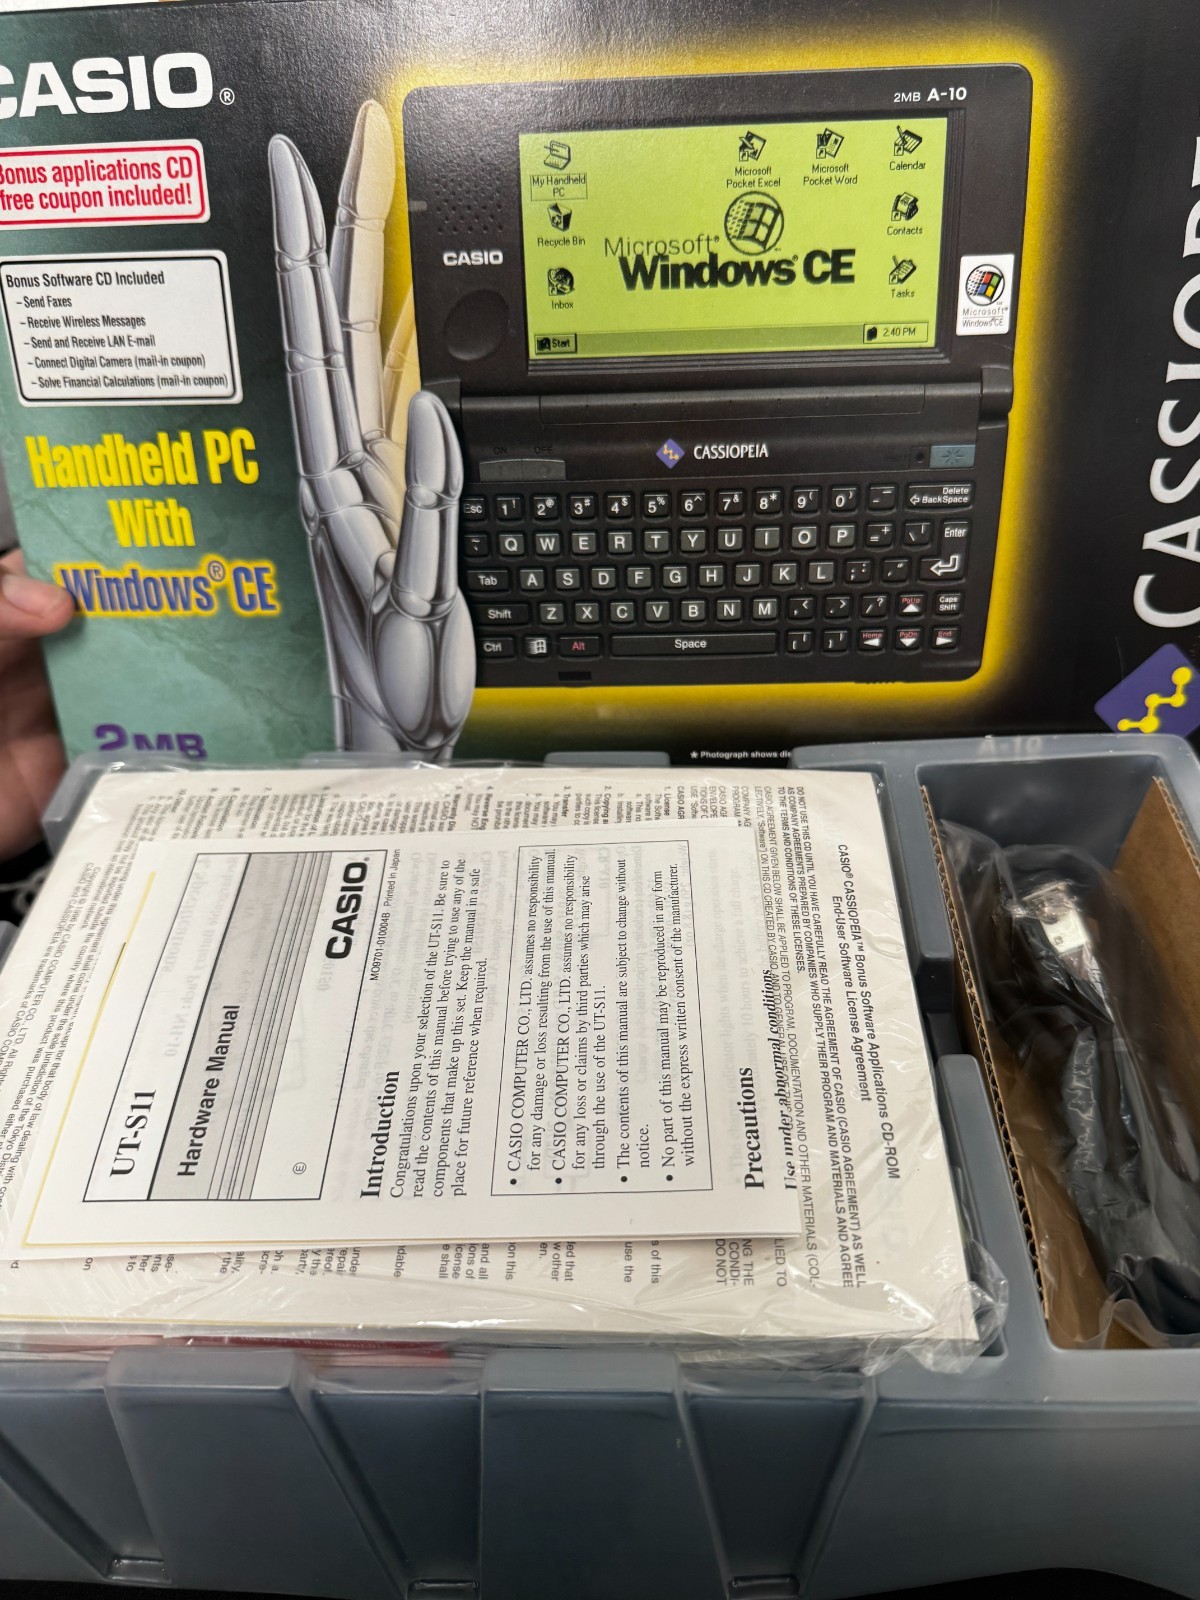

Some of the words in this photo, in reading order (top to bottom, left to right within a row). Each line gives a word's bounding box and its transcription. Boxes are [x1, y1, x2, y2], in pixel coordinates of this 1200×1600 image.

[893, 92, 921, 103] 2MB
[926, 87, 967, 102] A-10
[0, 164, 47, 184] onus
[52, 158, 161, 187] applications
[166, 156, 193, 178] CD
[734, 166, 772, 176] Microsoft
[810, 163, 849, 173] Microsoft
[889, 161, 926, 170] Calendar
[532, 176, 544, 187] My
[546, 174, 586, 186] Handheld
[726, 179, 756, 189] Pocket
[757, 178, 781, 188] Excel
[803, 176, 832, 186] Pocket
[834, 175, 858, 185] Word
[39, 188, 104, 213] coupon
[108, 182, 192, 206] included!
[553, 187, 565, 197] PC
[886, 226, 923, 236] Contacts
[537, 237, 570, 248] Recycle
[572, 236, 586, 246] Bin
[442, 250, 504, 267] CASIO
[803, 248, 856, 285] CE
[6, 274, 40, 288] Bonus
[42, 273, 93, 286] Software
[95, 272, 112, 285] CD
[115, 270, 165, 285] Included
[890, 288, 915, 298] Tasks
[551, 301, 574, 310] Inbox
[27, 316, 61, 329] Receive
[62, 316, 100, 328] Wireless
[102, 315, 146, 330] Messages
[882, 327, 901, 337] 2:40
[902, 326, 916, 336] PM
[31, 336, 52, 348] Send
[54, 336, 70, 348] and
[72, 336, 106, 348] Receive
[108, 335, 125, 347] LAN
[128, 334, 156, 346] E-mail
[552, 338, 571, 348] Start
[34, 356, 68, 369] Connect
[70, 356, 98, 370] Digital
[100, 356, 133, 368] Camera
[134, 355, 169, 369] (mail-in
[171, 354, 206, 369] coupon)
[38, 376, 62, 388] Solve
[64, 376, 101, 388] Financial
[103, 375, 155, 388] Calculations
[157, 374, 192, 389] (mail-in
[193, 374, 229, 389] coupon)
[25, 430, 199, 488] Handheld
[202, 428, 259, 485] PC
[693, 444, 769, 460] CASSIOPEIA
[942, 487, 969, 495] Delete
[107, 497, 197, 548] With
[944, 528, 968, 538] Enter
[232, 566, 276, 611] CE
[478, 576, 498, 586] Tab
[938, 596, 958, 605] Caps
[938, 604, 958, 612] Shift
[488, 609, 512, 620] Shift
[483, 642, 502, 652] Ctrl
[572, 641, 586, 651] Alt
[674, 639, 707, 650] Space
[700, 751, 749, 760] Photograph
[750, 750, 778, 759] shows
[796, 786, 805, 796] DO
[798, 796, 807, 810] NOT
[799, 810, 809, 824] USE
[802, 825, 811, 840] THIS
[803, 841, 812, 852] CD
[389, 848, 401, 871] Japan
[440, 860, 451, 869] to
[804, 852, 815, 873] UNTIL
[439, 871, 449, 891] sure
[615, 859, 627, 893] without
[807, 874, 817, 890] YOU
[383, 880, 396, 907] Printed
[527, 855, 543, 918] responsibility
[433, 893, 447, 907] Be
[809, 891, 820, 912] HAVE
[615, 895, 630, 929] change
[832, 895, 847, 941] End-User
[427, 908, 445, 948] UT-S11.
[527, 919, 537, 932] no
[617, 930, 627, 941] to
[369, 912, 391, 981] MO9701-010004B
[812, 913, 826, 960] CAREFULLY
[424, 950, 439, 966] the
[524, 934, 536, 975] assumes
[615, 942, 631, 978] subject
[421, 968, 436, 980] of
[818, 961, 830, 985] READ
[838, 942, 854, 988] Software
[854, 954, 868, 988] Bonus
[519, 977, 533, 1006] LTD.
[618, 980, 628, 997] are
[821, 986, 832, 1005] THE
[416, 982, 434, 1030] selection
[845, 990, 860, 1034] License
[860, 990, 876, 1040] Software
[517, 1008, 533, 1036] CO.,
[615, 1000, 629, 1042] manual
[823, 1005, 840, 1065] AGREEMENT
[414, 1032, 432, 1060] your
[616, 1044, 629, 1067] this
[409, 1062, 424, 1093] upon
[511, 1038, 529, 1119] COMPUTER
[616, 1068, 629, 1083] of
[831, 1066, 843, 1081] OF
[850, 1035, 873, 1102] Agreement
[176, 1077, 220, 1176] Hardware
[205, 1005, 241, 1072] Manual
[866, 1042, 889, 1119] Applications
[833, 1082, 847, 1114] CASIO
[618, 1086, 630, 1139] contents
[109, 1089, 157, 1177] UT-S11
[359, 1071, 400, 1199] Introduction
[736, 1067, 765, 1189] Precautions
[835, 1116, 852, 1154] (CASIO
[389, 1095, 418, 1198] Congratulations
[507, 1122, 524, 1172] CASIO
[616, 1142, 630, 1169] The
[635, 1124, 650, 1168] notice.
[880, 1122, 901, 1179] CD-ROM
[842, 1155, 861, 1231] AGREEMENT)
[851, 1233, 863, 1250] AS
[854, 1253, 866, 1288] WELL
